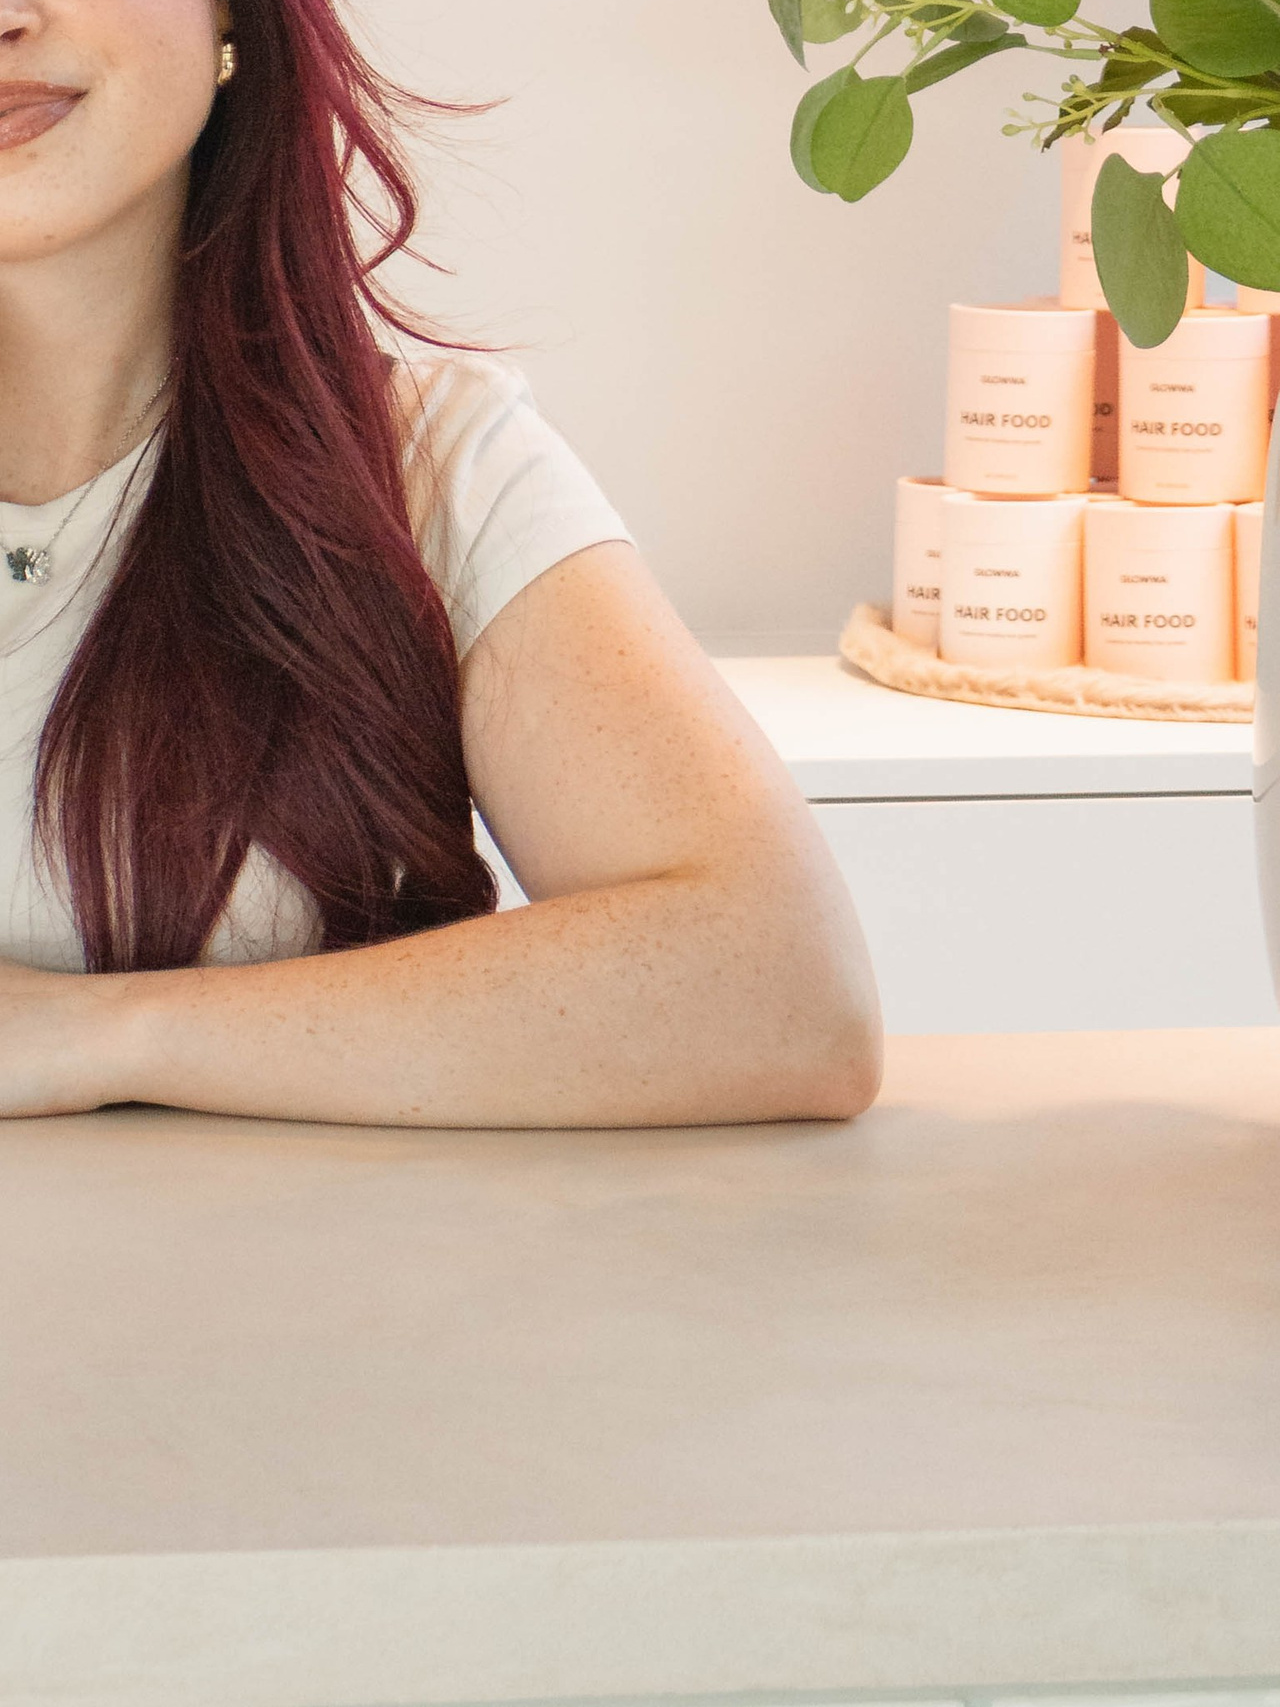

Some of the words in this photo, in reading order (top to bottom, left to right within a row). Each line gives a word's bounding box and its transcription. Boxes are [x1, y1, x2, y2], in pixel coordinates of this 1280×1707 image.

[961, 411, 995, 426] HAIR
[1001, 413, 1052, 429] FOOD
[1131, 420, 1165, 436] HAIR
[1171, 420, 1222, 437] FOOD
[907, 583, 940, 601] HAIR
[954, 604, 990, 621] HAIR
[996, 606, 1047, 623] FOOD
[1100, 612, 1138, 629] HAIR
[1145, 613, 1195, 630] FOOD
